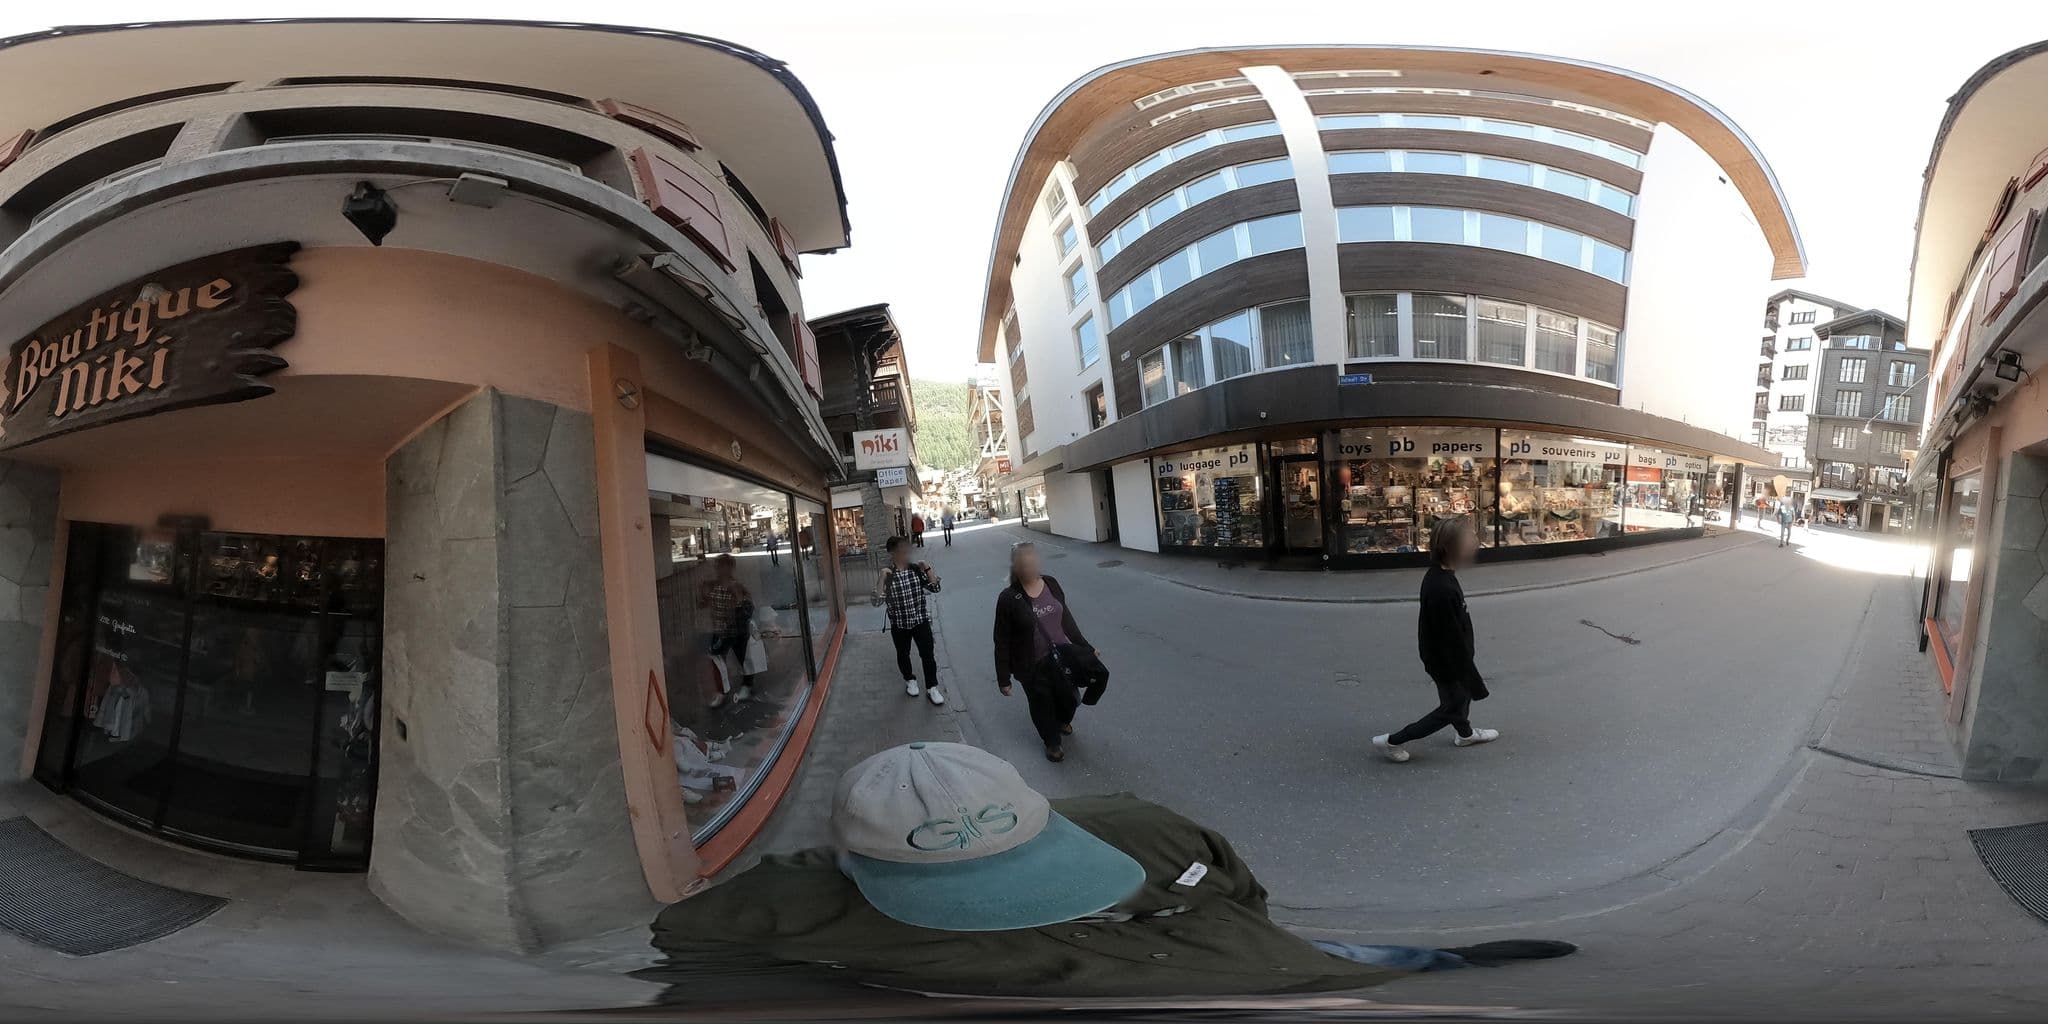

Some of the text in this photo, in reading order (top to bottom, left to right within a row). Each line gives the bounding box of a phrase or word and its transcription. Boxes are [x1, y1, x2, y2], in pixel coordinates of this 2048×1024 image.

[13, 278, 233, 411] Boutique
[1338, 436, 1483, 456] toys pb papers
[1510, 439, 1531, 456] pb
[1542, 446, 1596, 458] souvenirs
[1158, 451, 1249, 476] pb luggage pb
[1638, 454, 1702, 470] bags pb optics
[878, 469, 904, 478] Office
[879, 477, 903, 486] Paper
